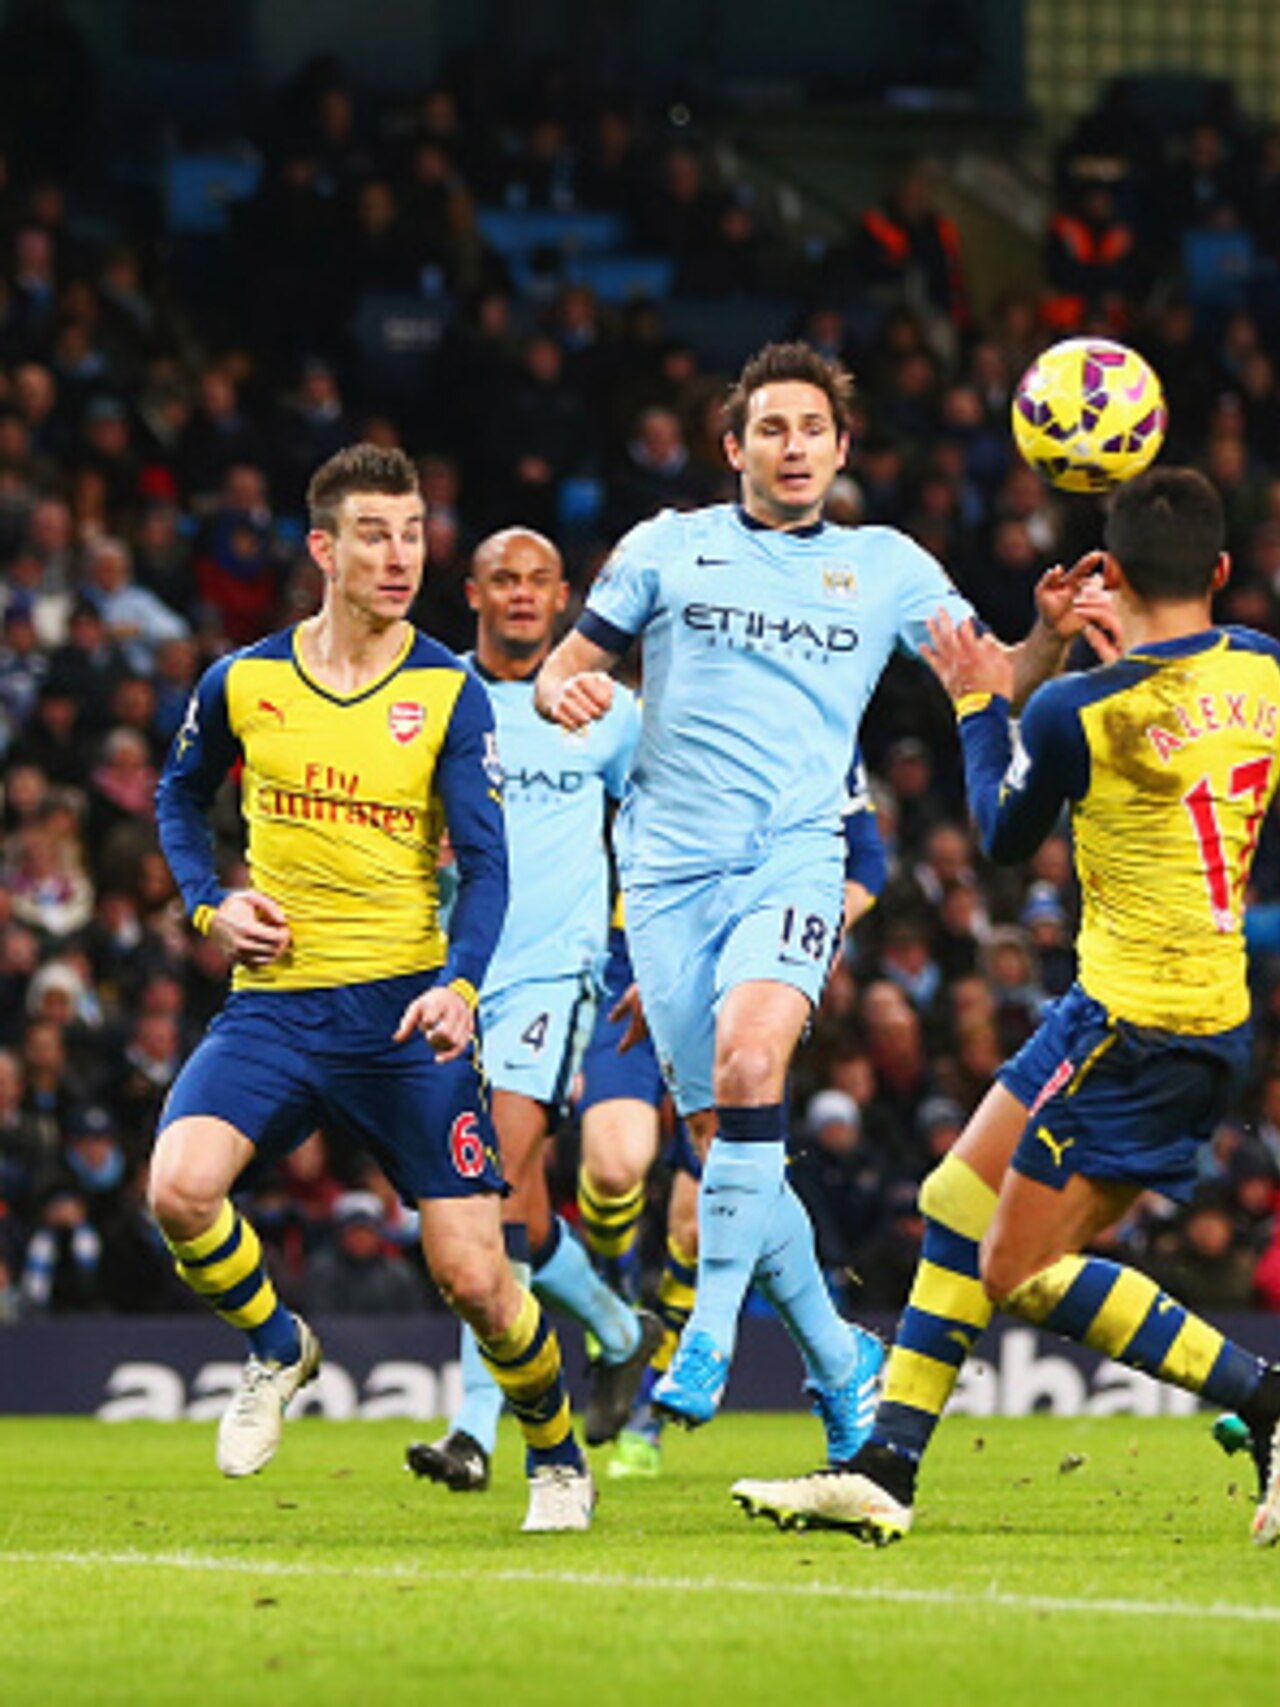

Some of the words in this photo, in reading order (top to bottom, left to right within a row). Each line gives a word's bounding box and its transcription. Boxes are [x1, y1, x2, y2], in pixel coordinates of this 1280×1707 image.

[682, 603, 859, 652] ETIHAD
[1146, 692, 1278, 762] ALEXIS
[305, 762, 358, 798] Fly
[782, 906, 827, 960] 18
[520, 1011, 550, 1052] 4
[451, 1111, 485, 1177] 6
